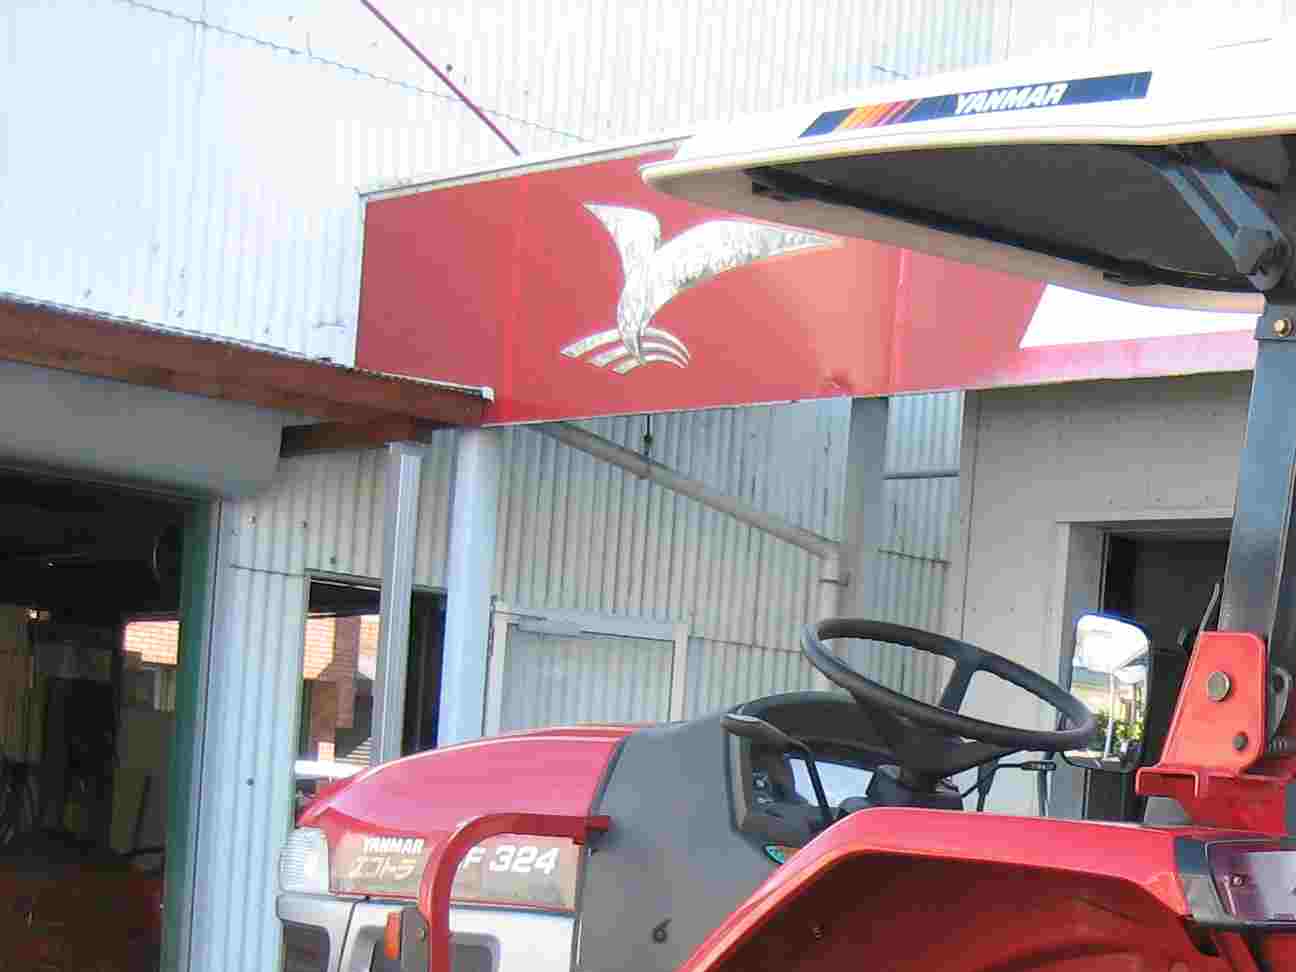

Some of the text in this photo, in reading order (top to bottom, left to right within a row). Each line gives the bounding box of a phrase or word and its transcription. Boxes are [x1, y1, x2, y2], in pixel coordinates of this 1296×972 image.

[954, 83, 1069, 115] YANMAR
[363, 837, 425, 855] YANMAR
[457, 845, 560, 874] F 324
